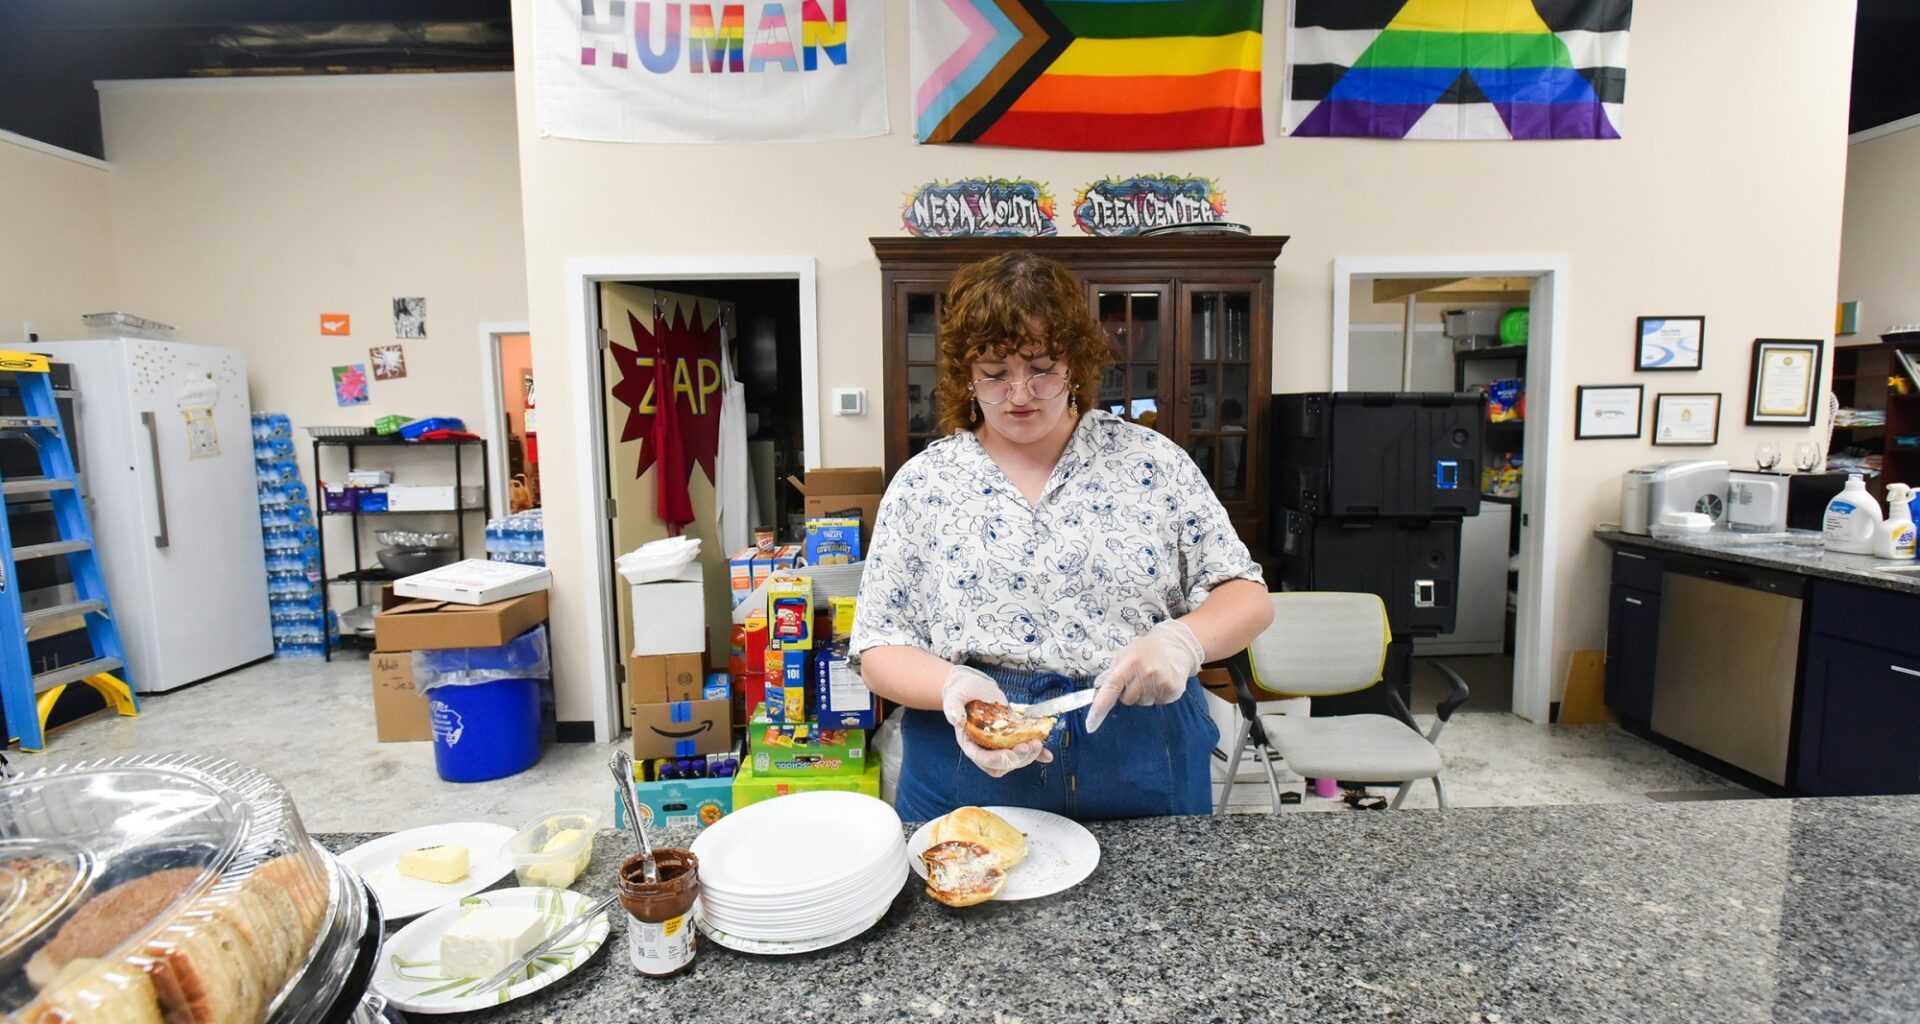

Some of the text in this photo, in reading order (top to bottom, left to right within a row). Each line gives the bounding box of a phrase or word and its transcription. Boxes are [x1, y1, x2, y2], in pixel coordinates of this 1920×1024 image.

[580, 0, 848, 75] HUMAN
[913, 187, 1043, 235] NEPA YOUTH
[1088, 190, 1213, 228] TEEN CENTER
[636, 357, 721, 415] ZAP
